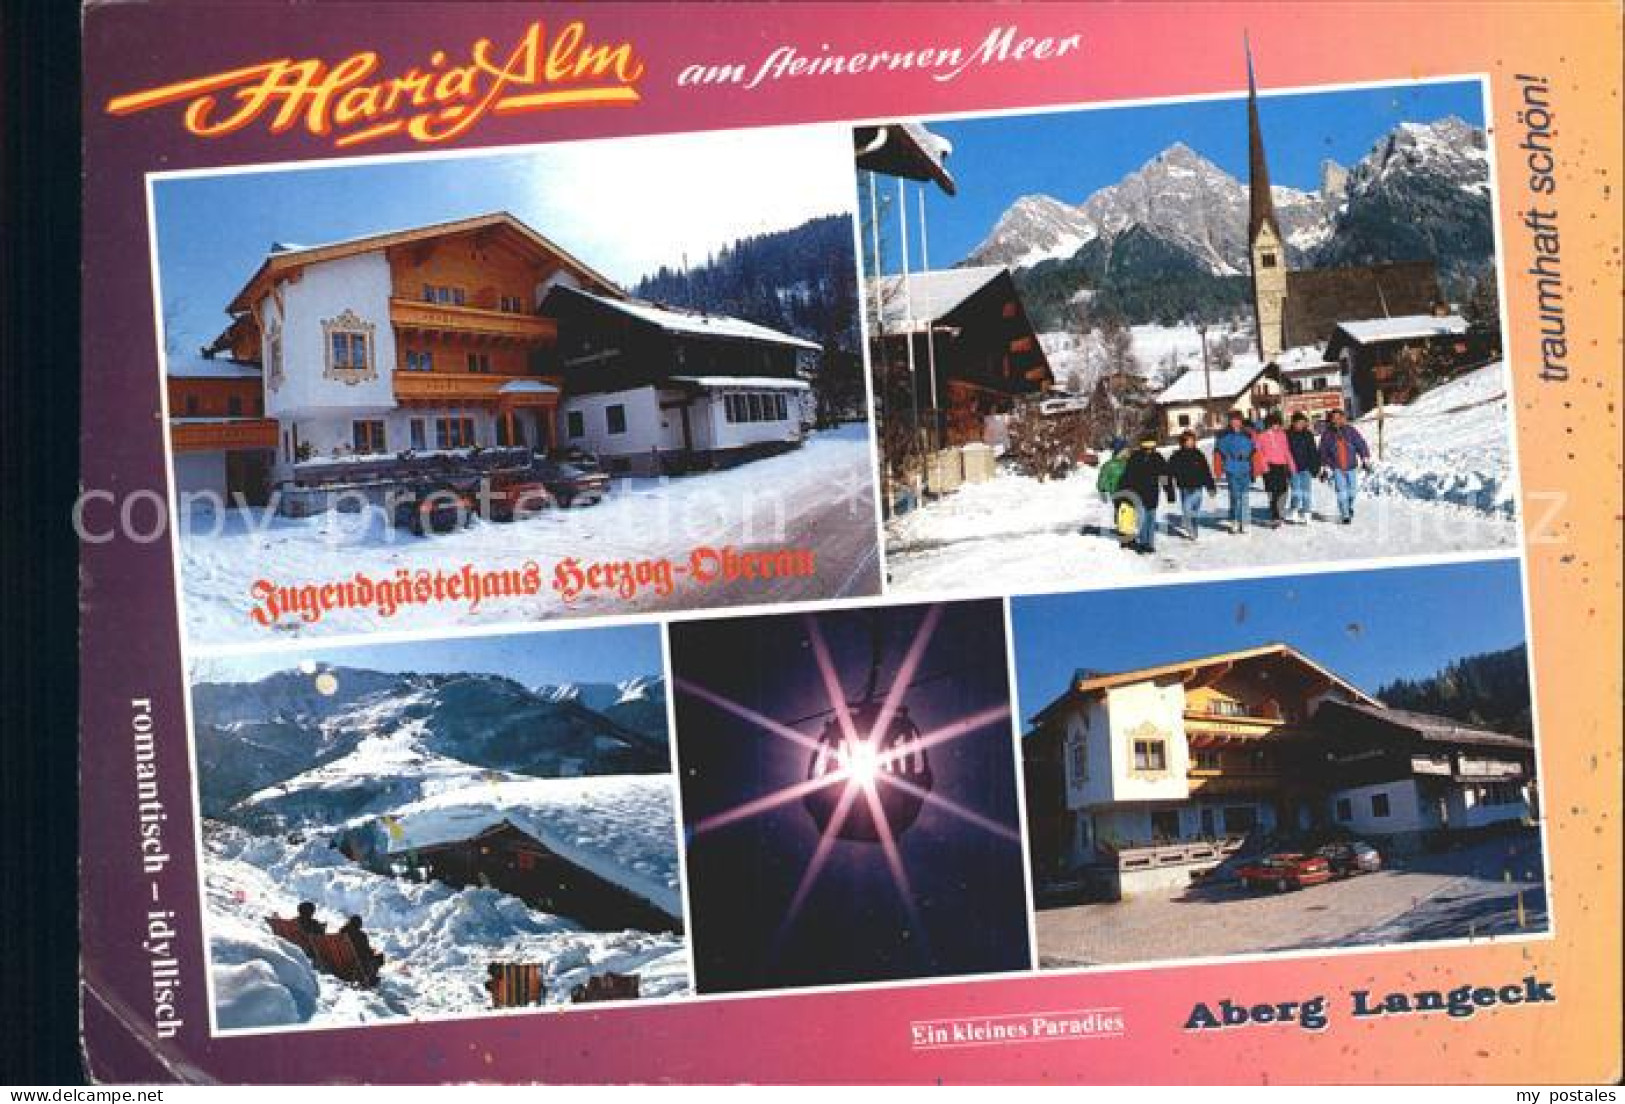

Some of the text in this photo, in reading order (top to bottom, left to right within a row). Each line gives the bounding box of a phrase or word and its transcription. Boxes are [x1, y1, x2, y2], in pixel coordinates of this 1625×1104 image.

[106, 20, 643, 143] Maria Alm
[677, 25, 1083, 89] am steinernen Meer
[1514, 74, 1569, 383] traumhaft schön!
[249, 544, 817, 627] Jugendgästehaus Herzog-Oberau
[131, 698, 171, 873] romantisch
[143, 909, 184, 1039] idyllisch
[1182, 976, 1557, 1031] Aberg Langeck
[911, 1013, 1125, 1045] Ein kleines Paradies
